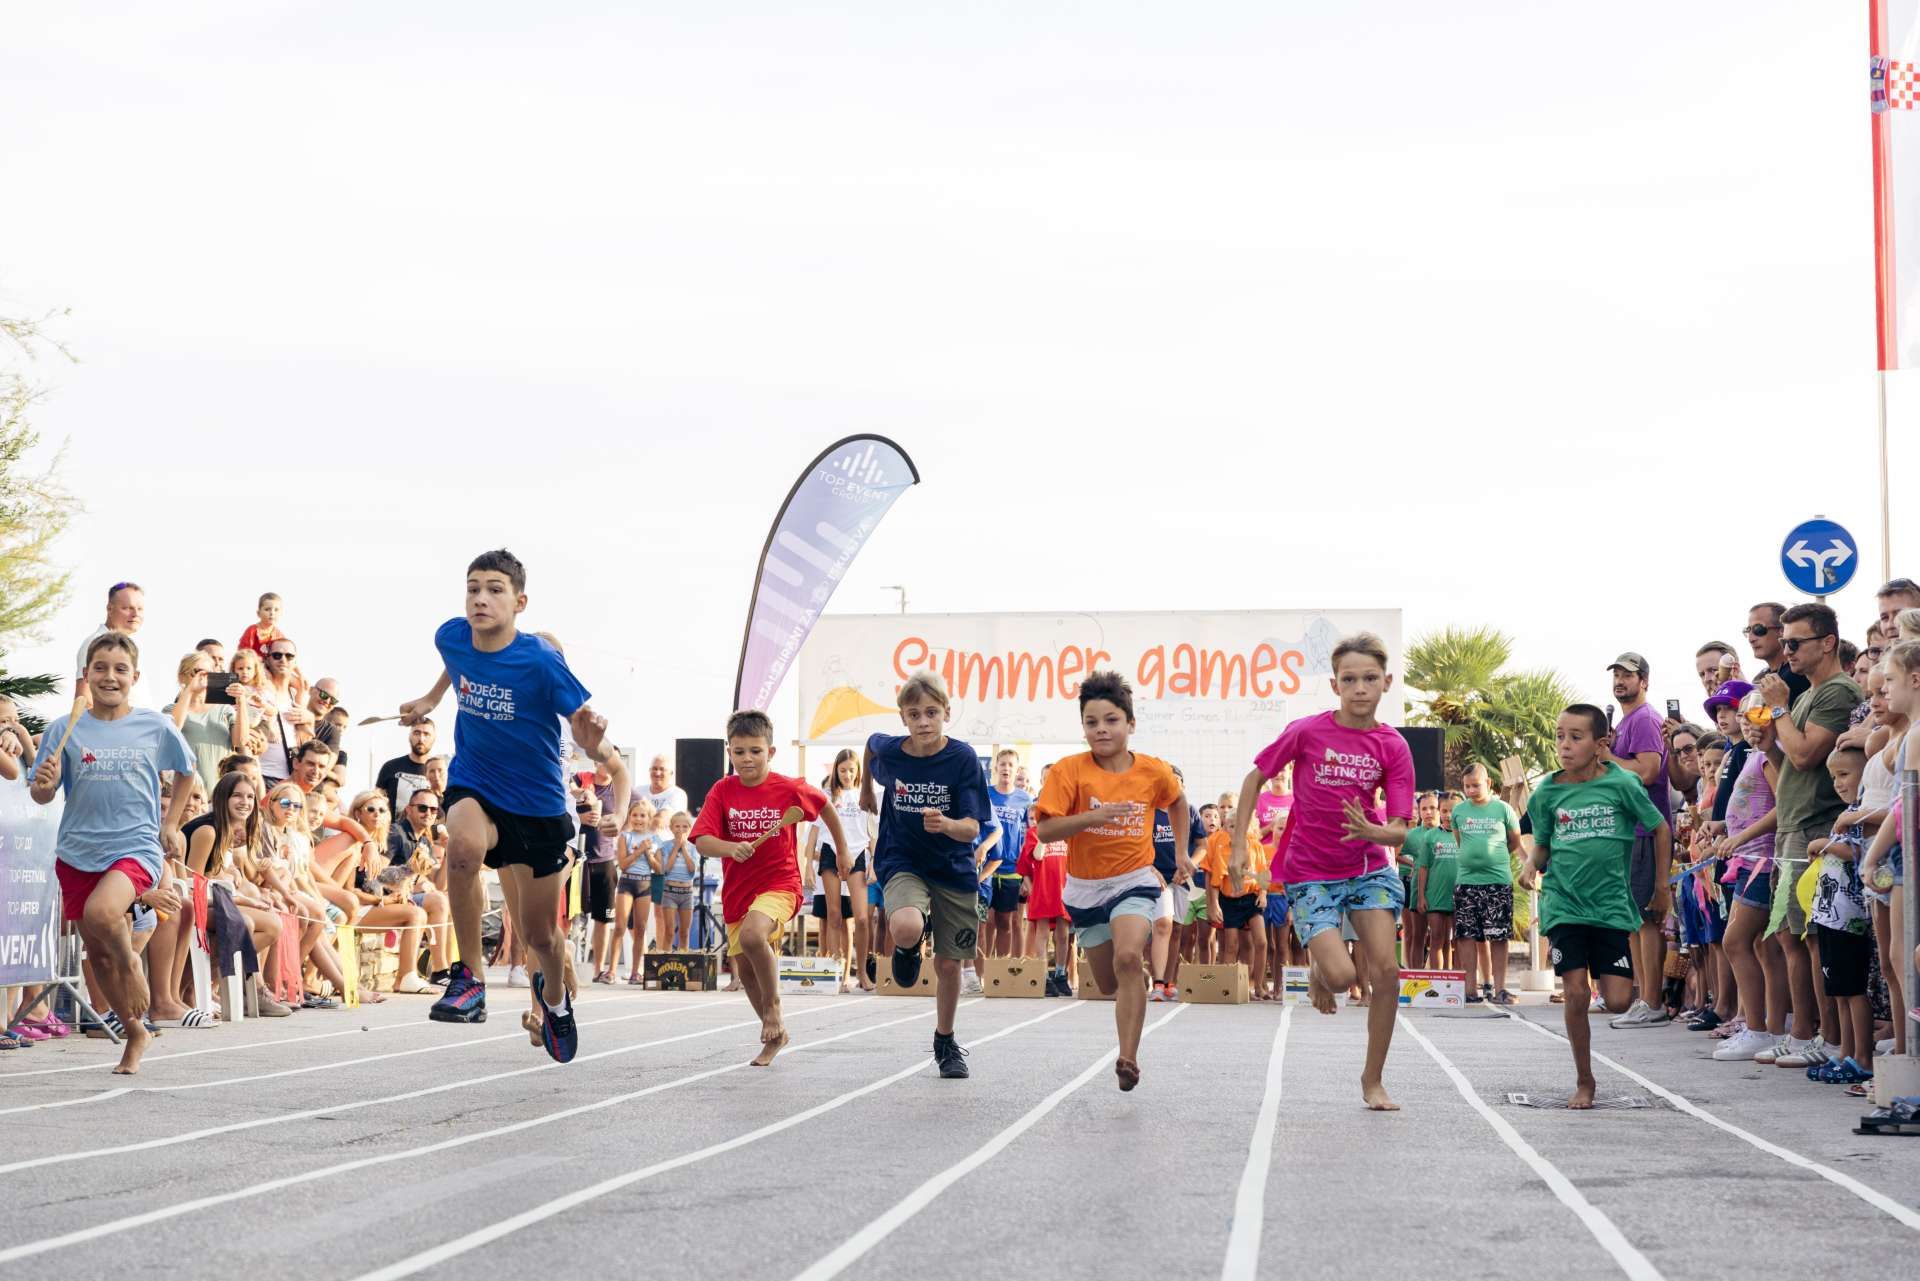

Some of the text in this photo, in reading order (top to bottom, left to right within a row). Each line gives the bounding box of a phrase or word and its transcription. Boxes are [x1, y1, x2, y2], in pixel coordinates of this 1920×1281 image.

[819, 470, 846, 487] TOP
[893, 637, 1305, 702] Summer games
[468, 681, 512, 701] DJEČJE
[457, 691, 516, 714] ETNE IGRE
[94, 746, 144, 760] DJEČJE
[907, 781, 948, 794] DJEČJE
[894, 792, 951, 805] ETNE IGRE
[740, 806, 780, 820] DJEČJE
[1568, 804, 1615, 820] DJEČJE
[728, 820, 757, 830] JETNE
[1591, 816, 1616, 829] IGRE
[8, 901, 19, 914] TOP
